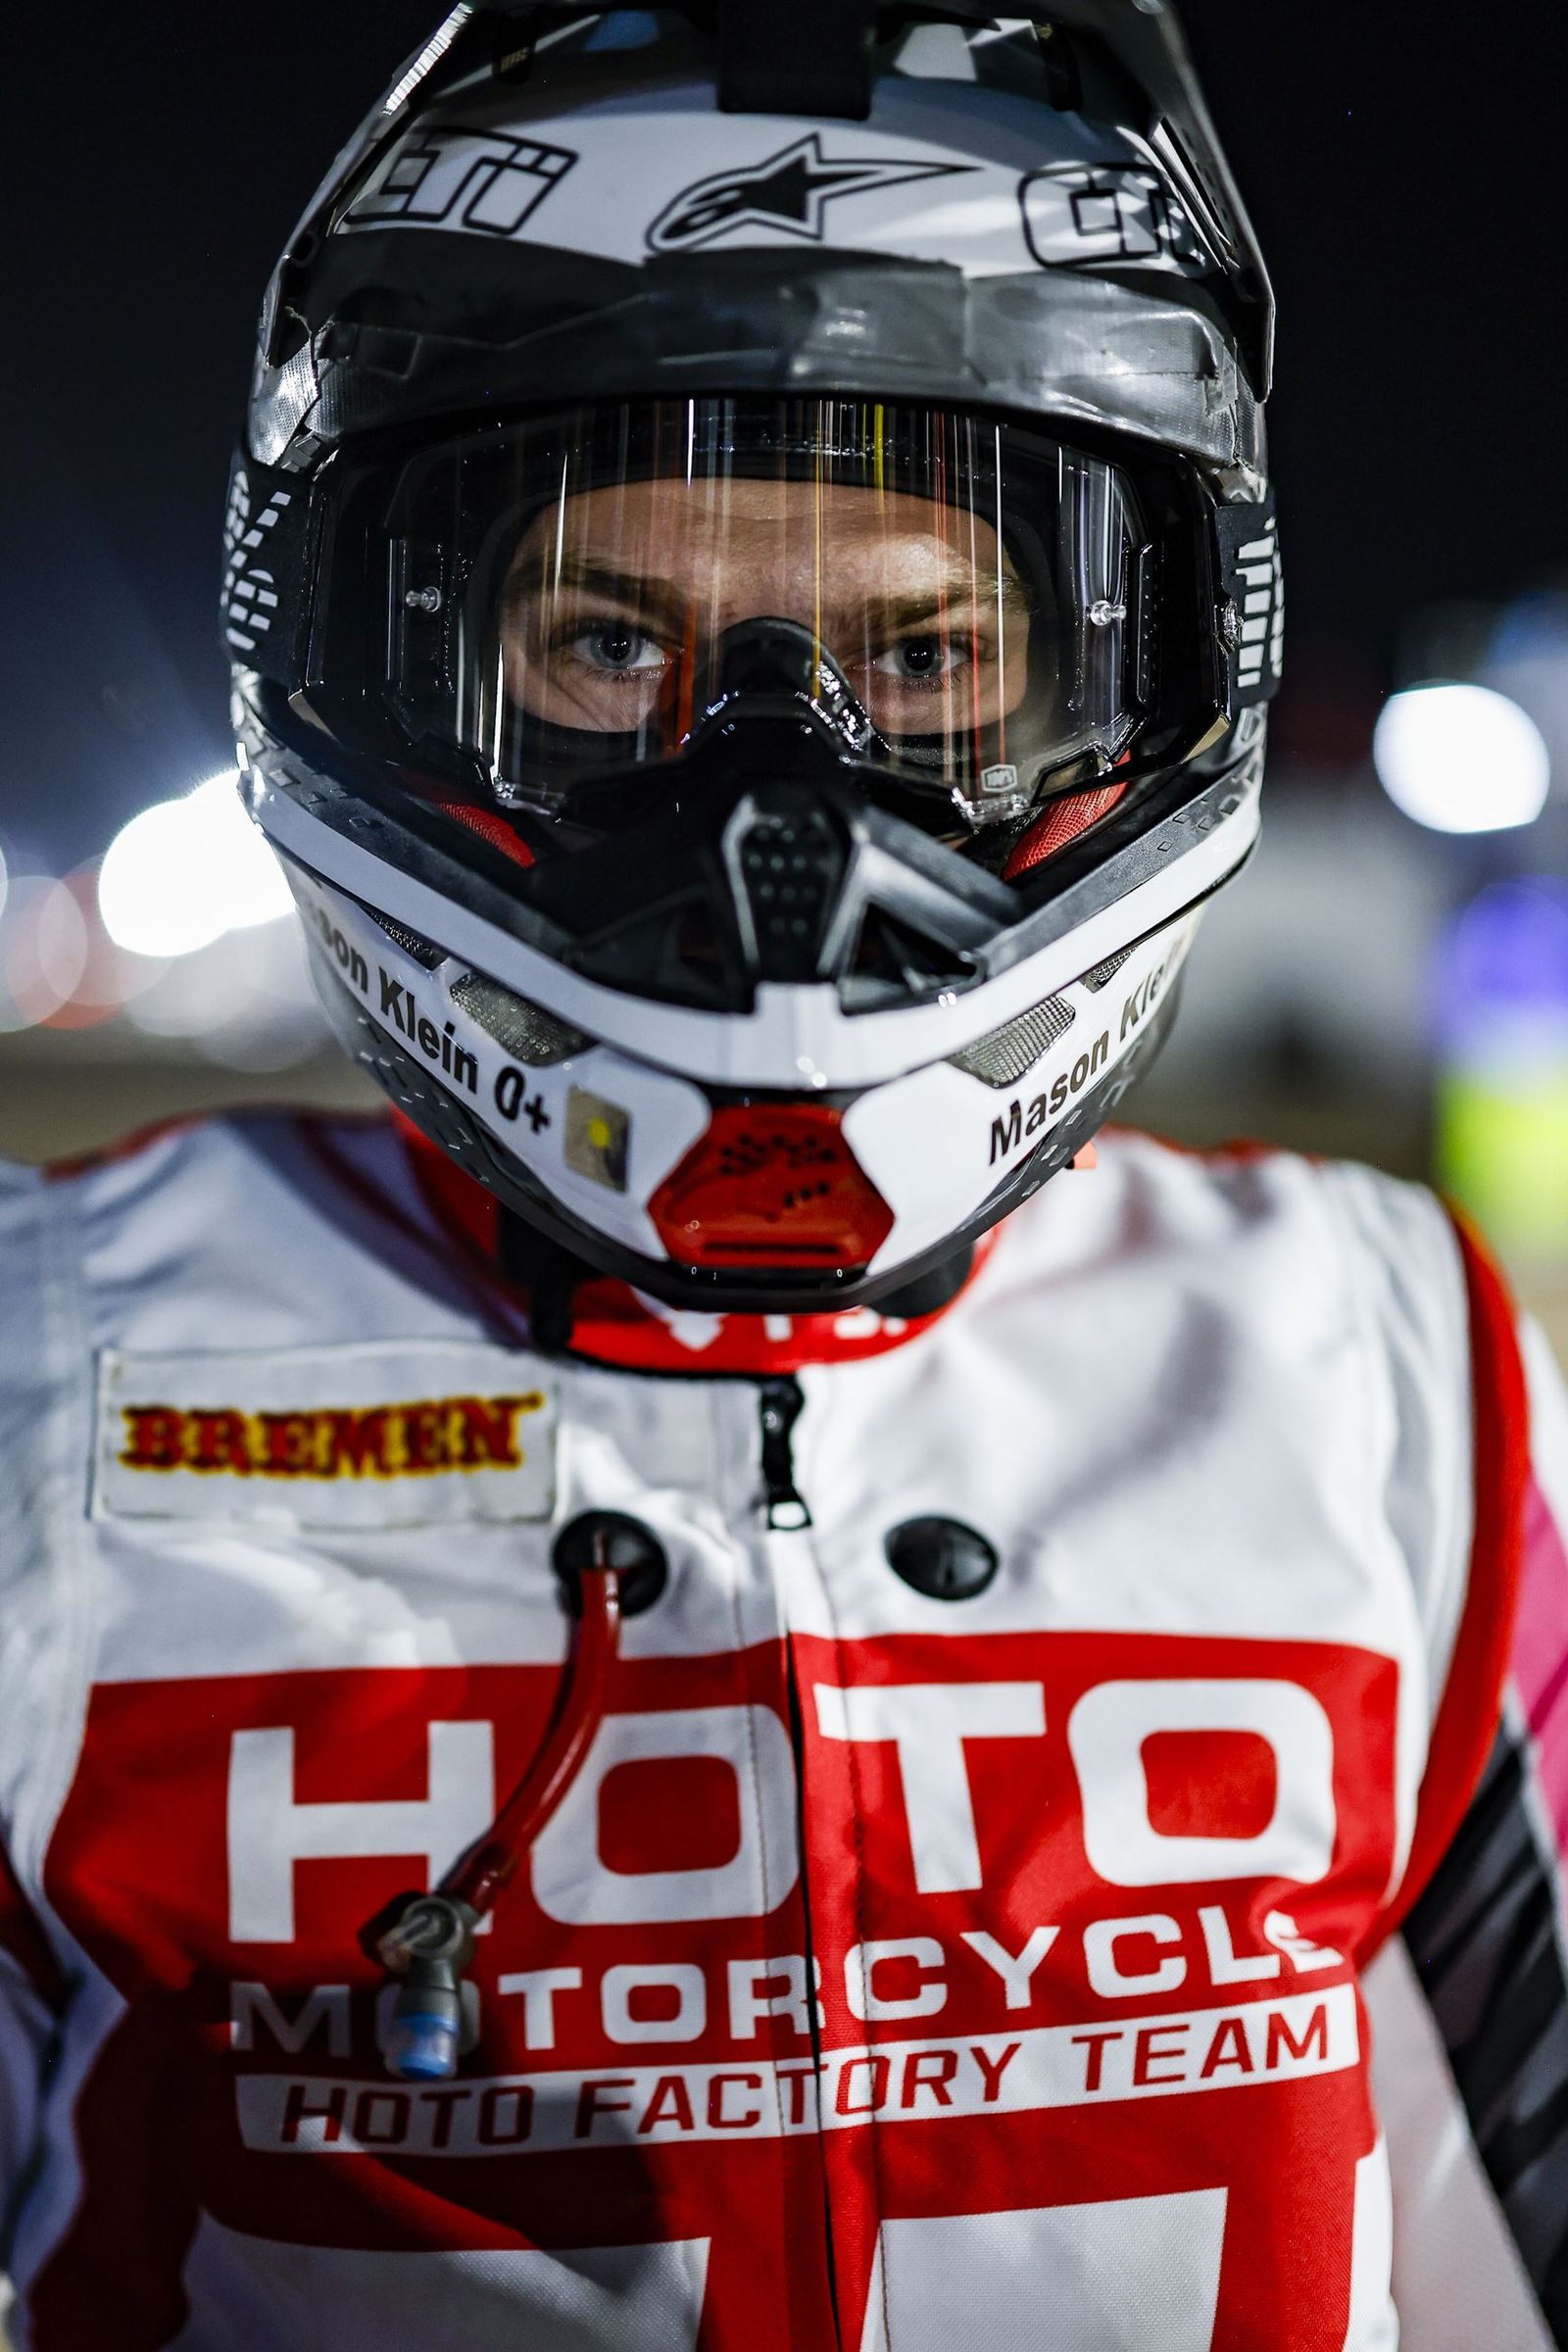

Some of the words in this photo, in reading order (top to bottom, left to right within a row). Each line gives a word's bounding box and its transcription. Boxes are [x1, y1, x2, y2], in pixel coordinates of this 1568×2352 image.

[378, 965, 478, 1095] Klein
[989, 1029, 1109, 1166] Mason
[118, 1392, 543, 1480] BREMEN
[226, 1679, 1336, 1944] HOTO
[281, 2082, 535, 2150] HOTO
[574, 2042, 1022, 2140] FACTORY
[1071, 2003, 1329, 2093] TEAM
